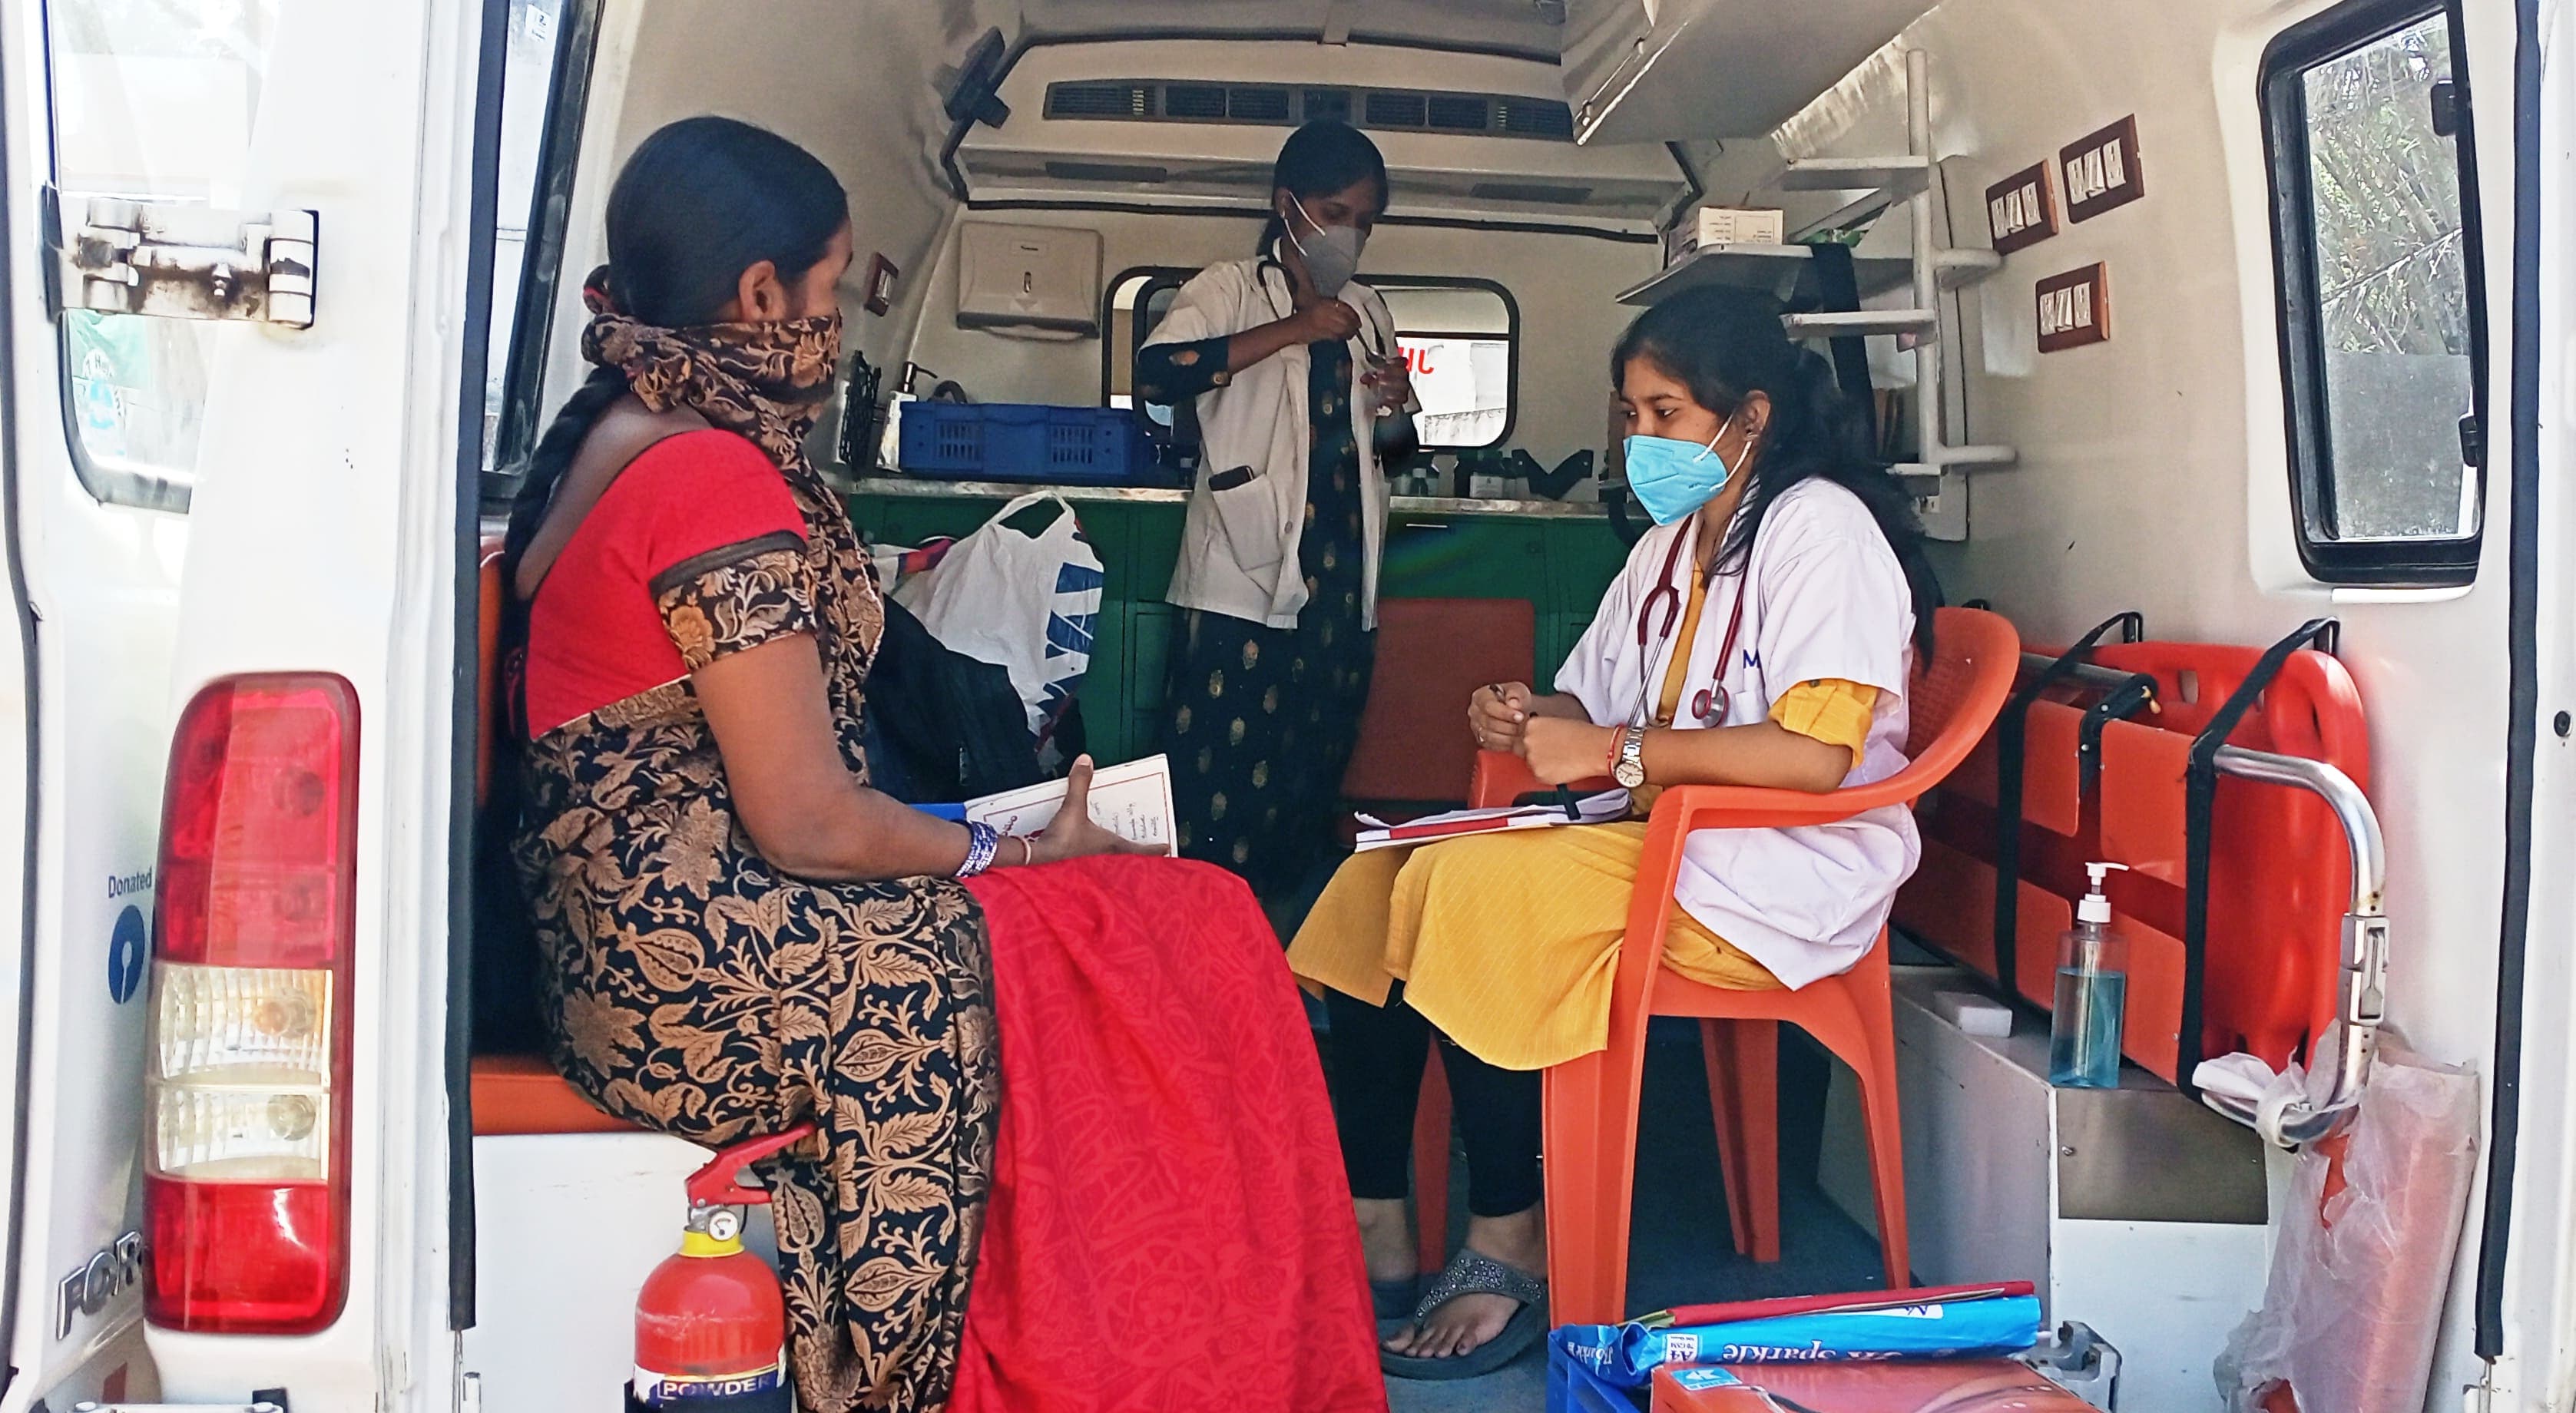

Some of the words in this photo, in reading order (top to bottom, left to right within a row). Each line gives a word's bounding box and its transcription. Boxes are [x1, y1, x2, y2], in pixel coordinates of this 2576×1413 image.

[108, 865, 153, 898] Donated
[1670, 1350, 1694, 1362] A4
[662, 1377, 770, 1397] POWDER
